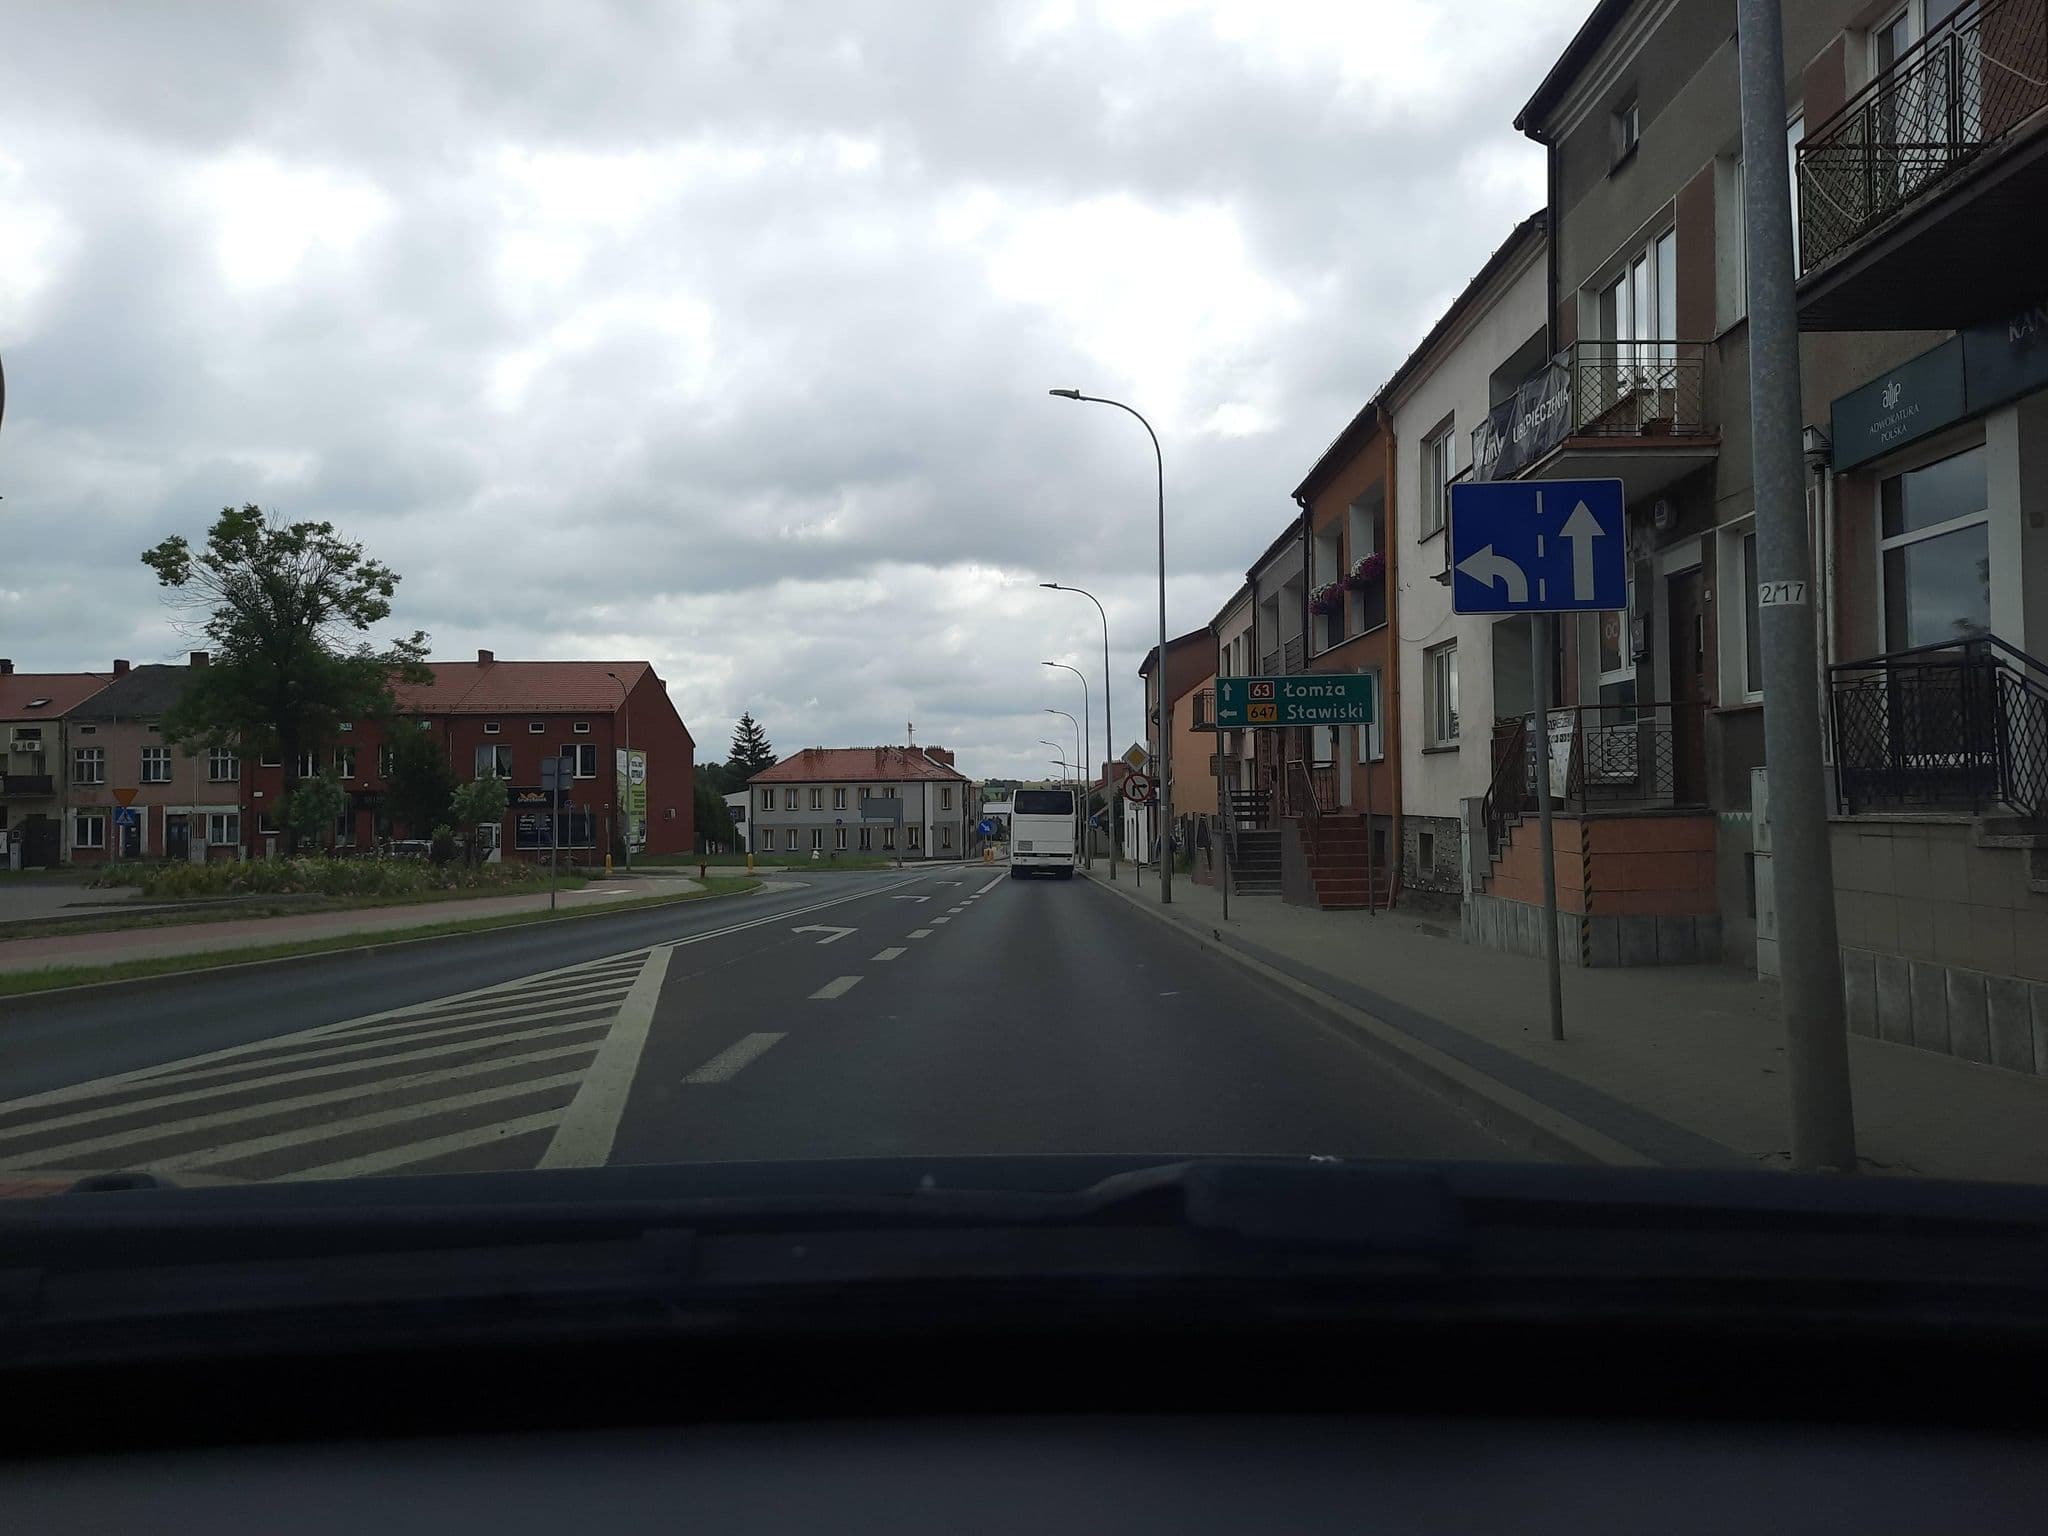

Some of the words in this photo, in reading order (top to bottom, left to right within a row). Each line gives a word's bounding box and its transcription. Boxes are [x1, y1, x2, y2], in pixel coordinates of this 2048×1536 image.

[1869, 403, 1920, 435] ADWOKATURA
[1881, 424, 1908, 444] POLSKA
[1253, 684, 1270, 697] 63
[1283, 681, 1346, 697] Łomża
[1250, 706, 1275, 719] 647
[1287, 702, 1363, 720] Stawiski
